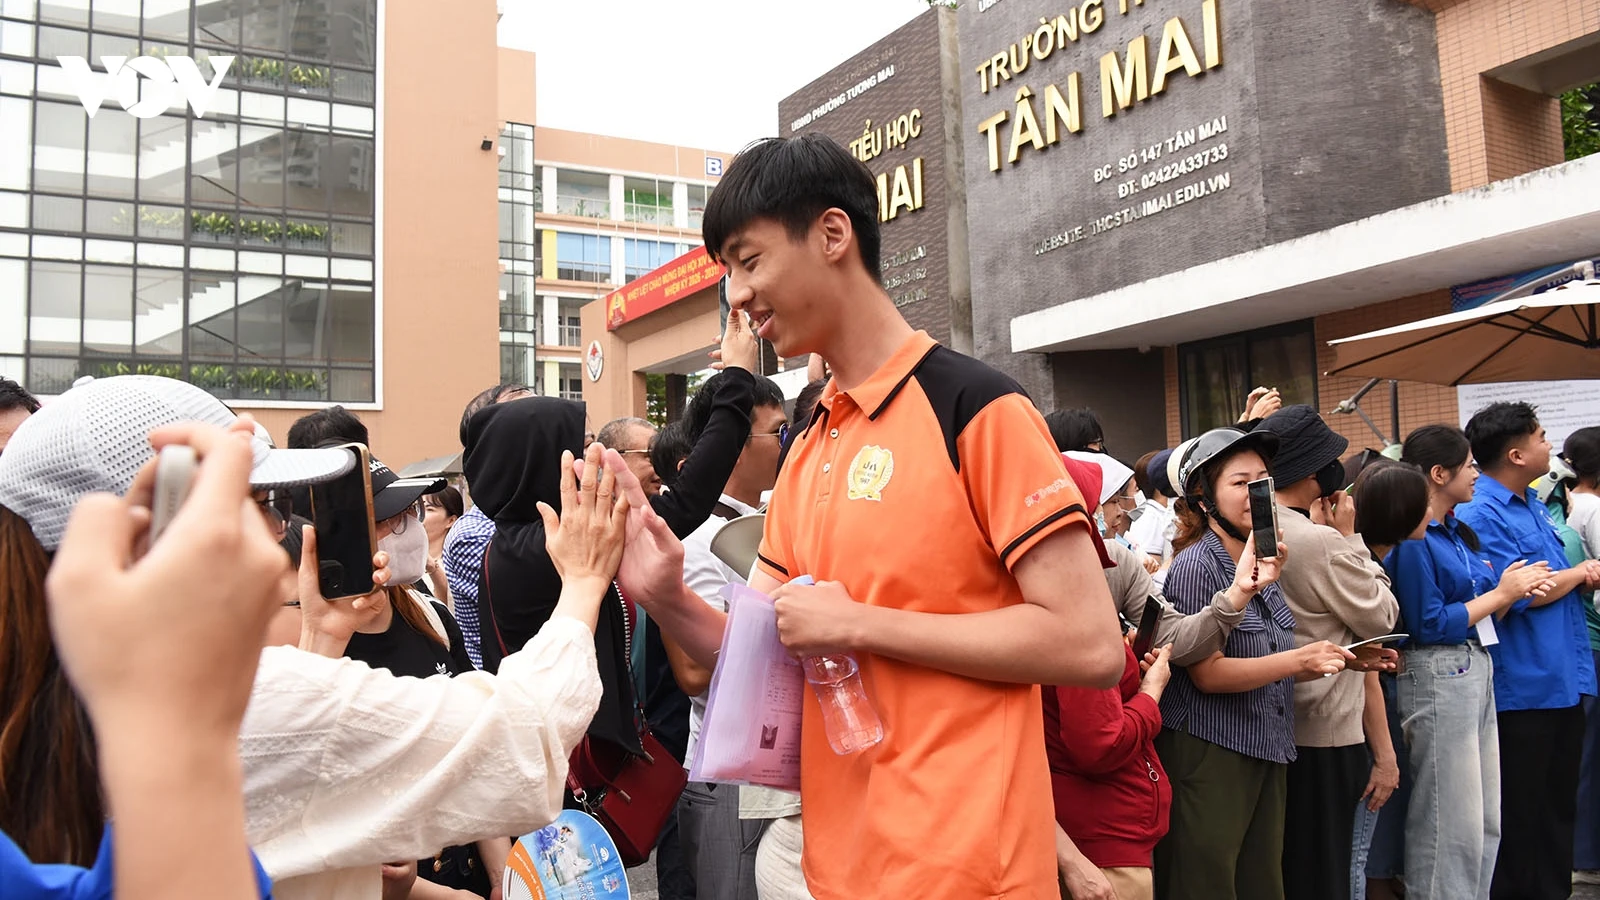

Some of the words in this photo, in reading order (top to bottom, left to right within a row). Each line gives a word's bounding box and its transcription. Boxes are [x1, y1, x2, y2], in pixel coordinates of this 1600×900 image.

[976, 0, 1105, 94] TRƯỜNG
[791, 112, 812, 132] UBND
[877, 64, 895, 83] MAI
[978, 71, 1083, 172] TÂN
[1100, 0, 1222, 119] MAI
[849, 119, 882, 162] TIỂU
[886, 108, 922, 150] HỌC
[1140, 142, 1164, 164] 147
[1165, 130, 1196, 154] TÂN
[1198, 115, 1228, 142] MAI
[707, 159, 721, 175] B
[1118, 179, 1140, 199] ĐT:
[1141, 143, 1228, 190] 02422433733
[1089, 172, 1231, 237] THCSTANMAI.EDU.VN
